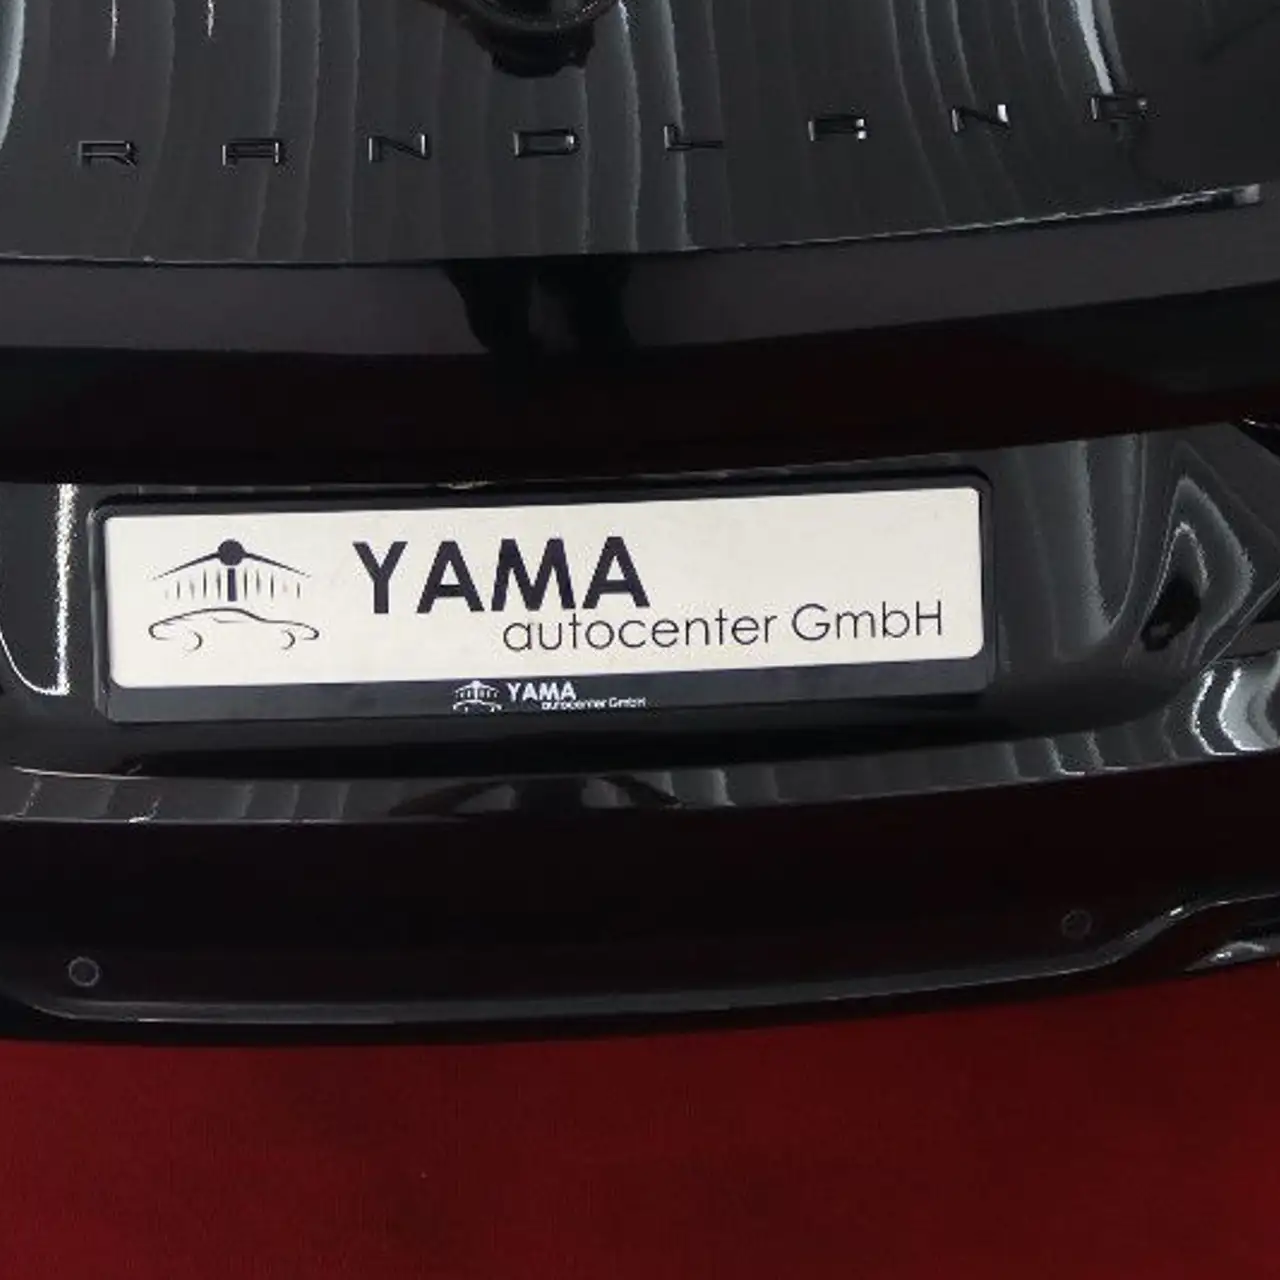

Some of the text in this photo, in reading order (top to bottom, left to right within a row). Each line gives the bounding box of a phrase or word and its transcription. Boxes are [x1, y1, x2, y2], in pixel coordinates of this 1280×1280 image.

[352, 535, 650, 614] YAMA
[503, 600, 942, 651] autocenter GmbH
[506, 681, 577, 702] YAMA
